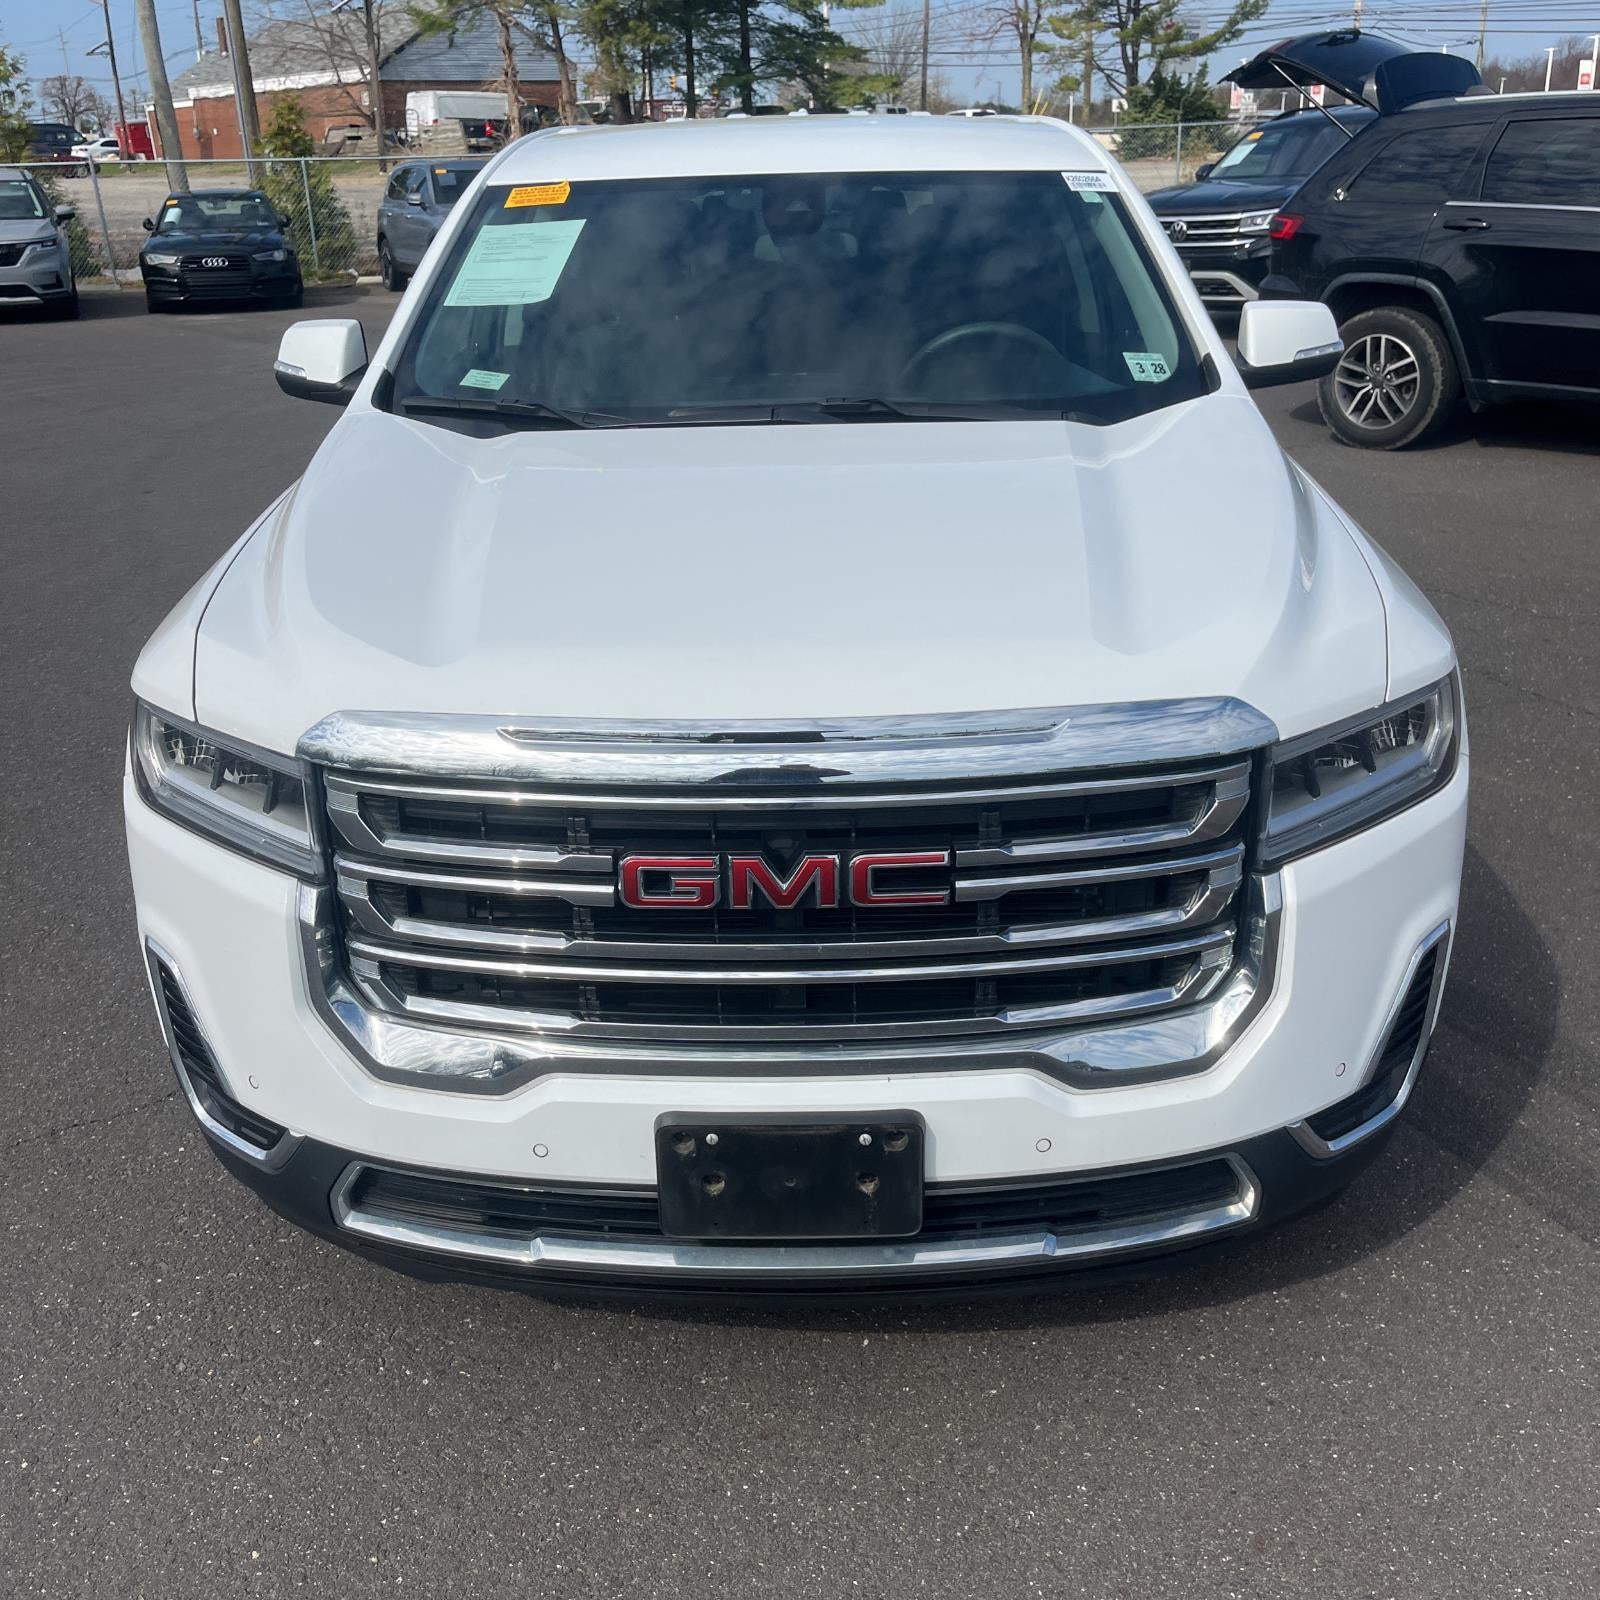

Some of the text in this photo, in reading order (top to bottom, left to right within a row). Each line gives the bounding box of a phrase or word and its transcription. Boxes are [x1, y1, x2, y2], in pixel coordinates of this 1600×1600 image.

[1135, 362, 1167, 375] 3 28
[618, 850, 950, 909] GMC
